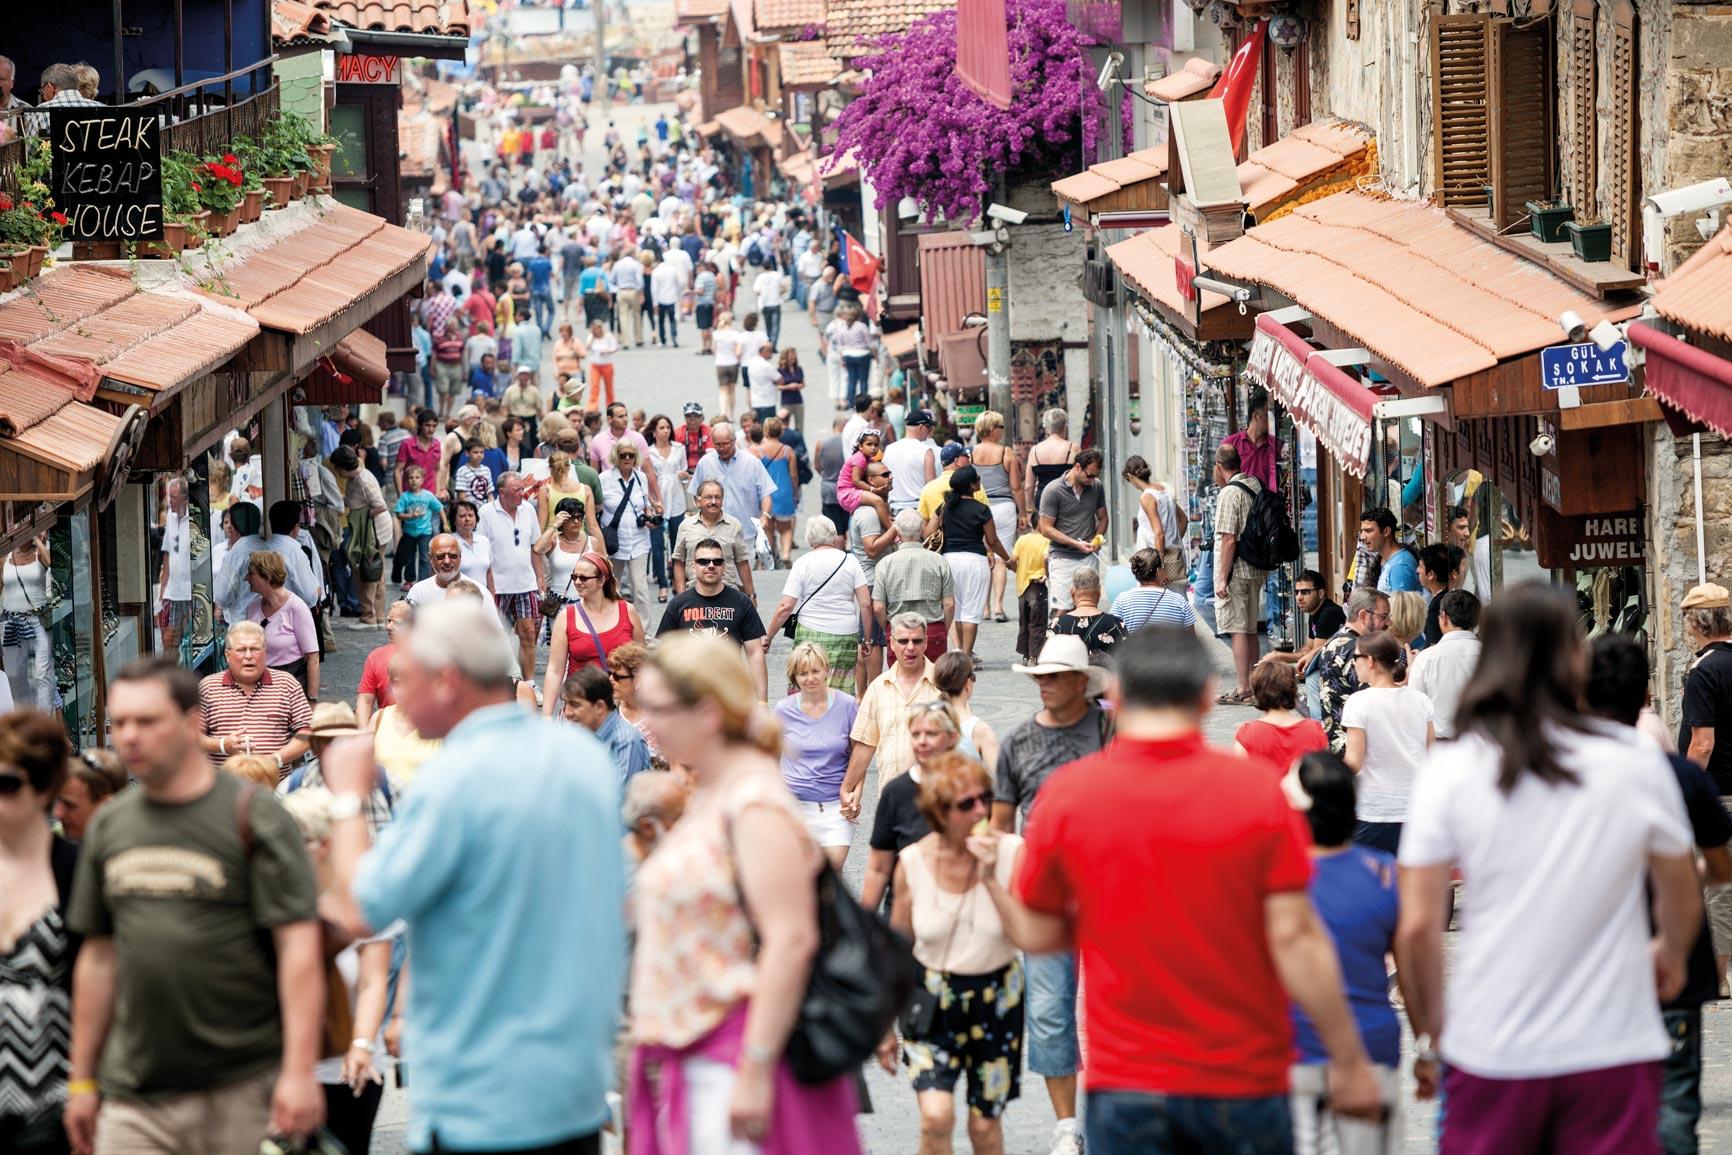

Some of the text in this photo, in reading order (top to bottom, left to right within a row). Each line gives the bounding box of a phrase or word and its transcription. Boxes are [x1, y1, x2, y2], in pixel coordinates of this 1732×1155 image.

[59, 117, 155, 152] STEAK
[62, 162, 156, 194] KEBAP
[61, 203, 160, 237] HOUSE
[1571, 346, 1597, 360] GÜL
[1553, 358, 1617, 376] SOKAK
[1570, 541, 1647, 560] JUWEL
[683, 606, 735, 622] VOLBEAT
